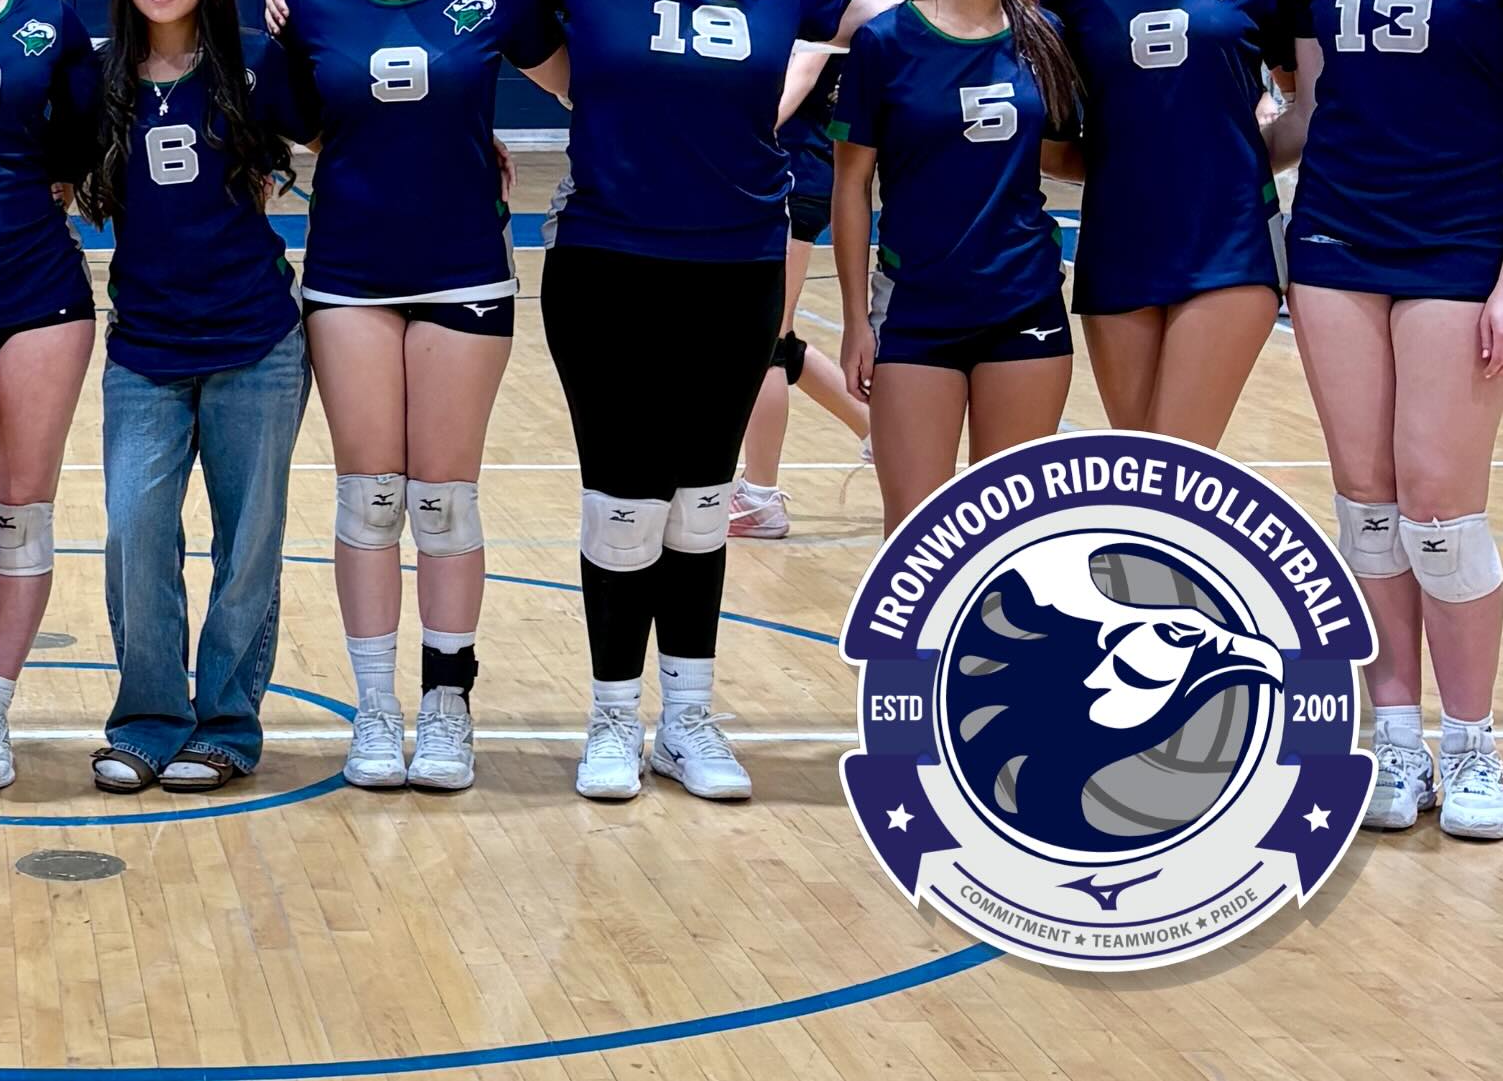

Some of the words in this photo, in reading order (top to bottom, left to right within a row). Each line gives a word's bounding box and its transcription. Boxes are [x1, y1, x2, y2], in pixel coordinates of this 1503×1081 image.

[651, 0, 751, 62] 19
[1130, 8, 1189, 69] 8
[370, 46, 429, 103] 9
[959, 83, 1018, 143] 5
[145, 124, 199, 186] 6
